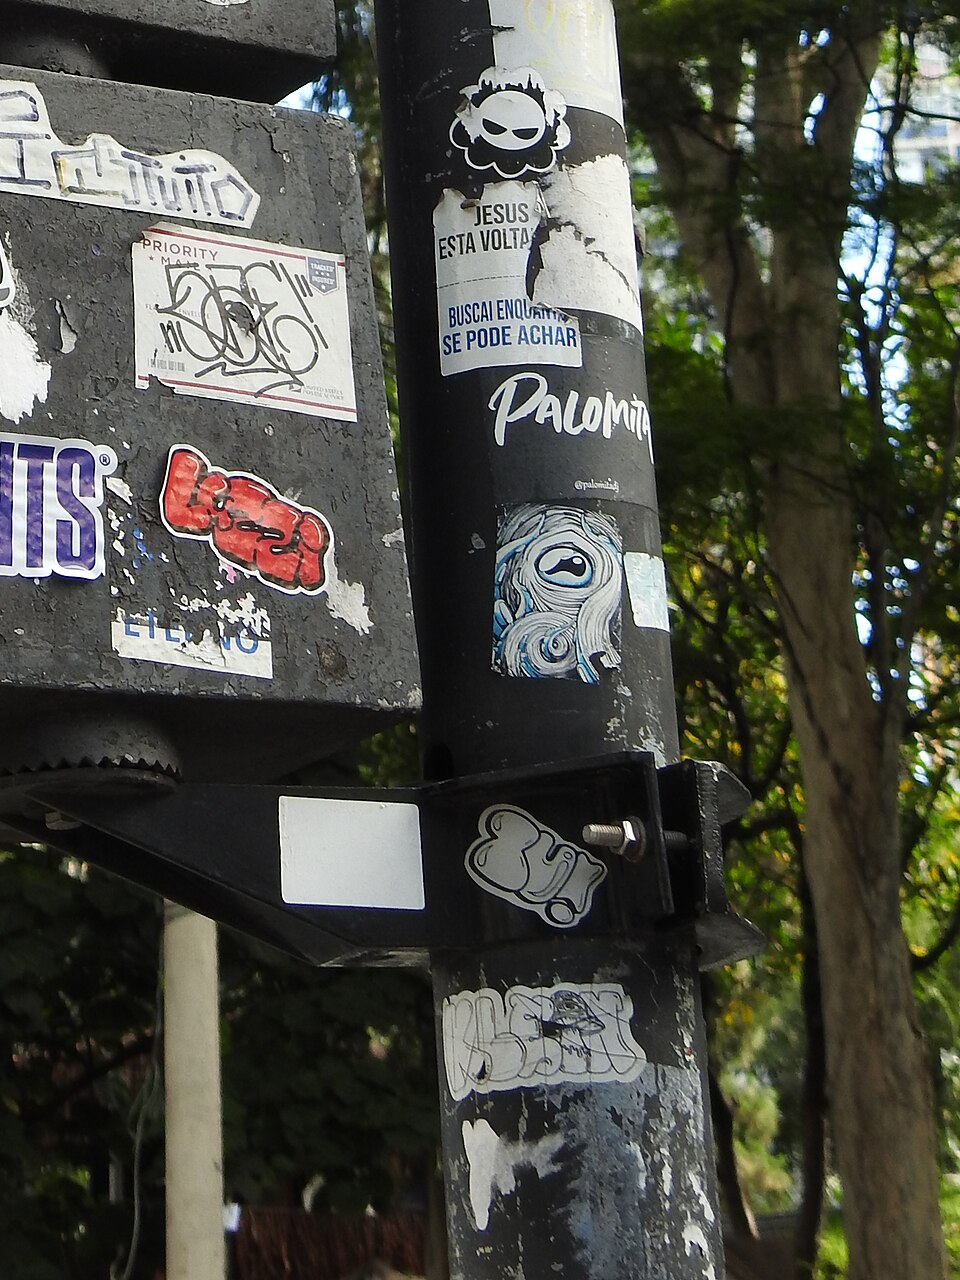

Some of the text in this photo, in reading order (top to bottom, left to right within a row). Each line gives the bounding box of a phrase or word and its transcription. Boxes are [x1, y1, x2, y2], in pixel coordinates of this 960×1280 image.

[474, 202, 529, 227] JESUS
[142, 238, 218, 261] PRIORITY
[439, 227, 535, 260] ESTA VOLTA
[449, 299, 493, 328] BUSCAI
[443, 324, 577, 356] SE PODE ACHAR
